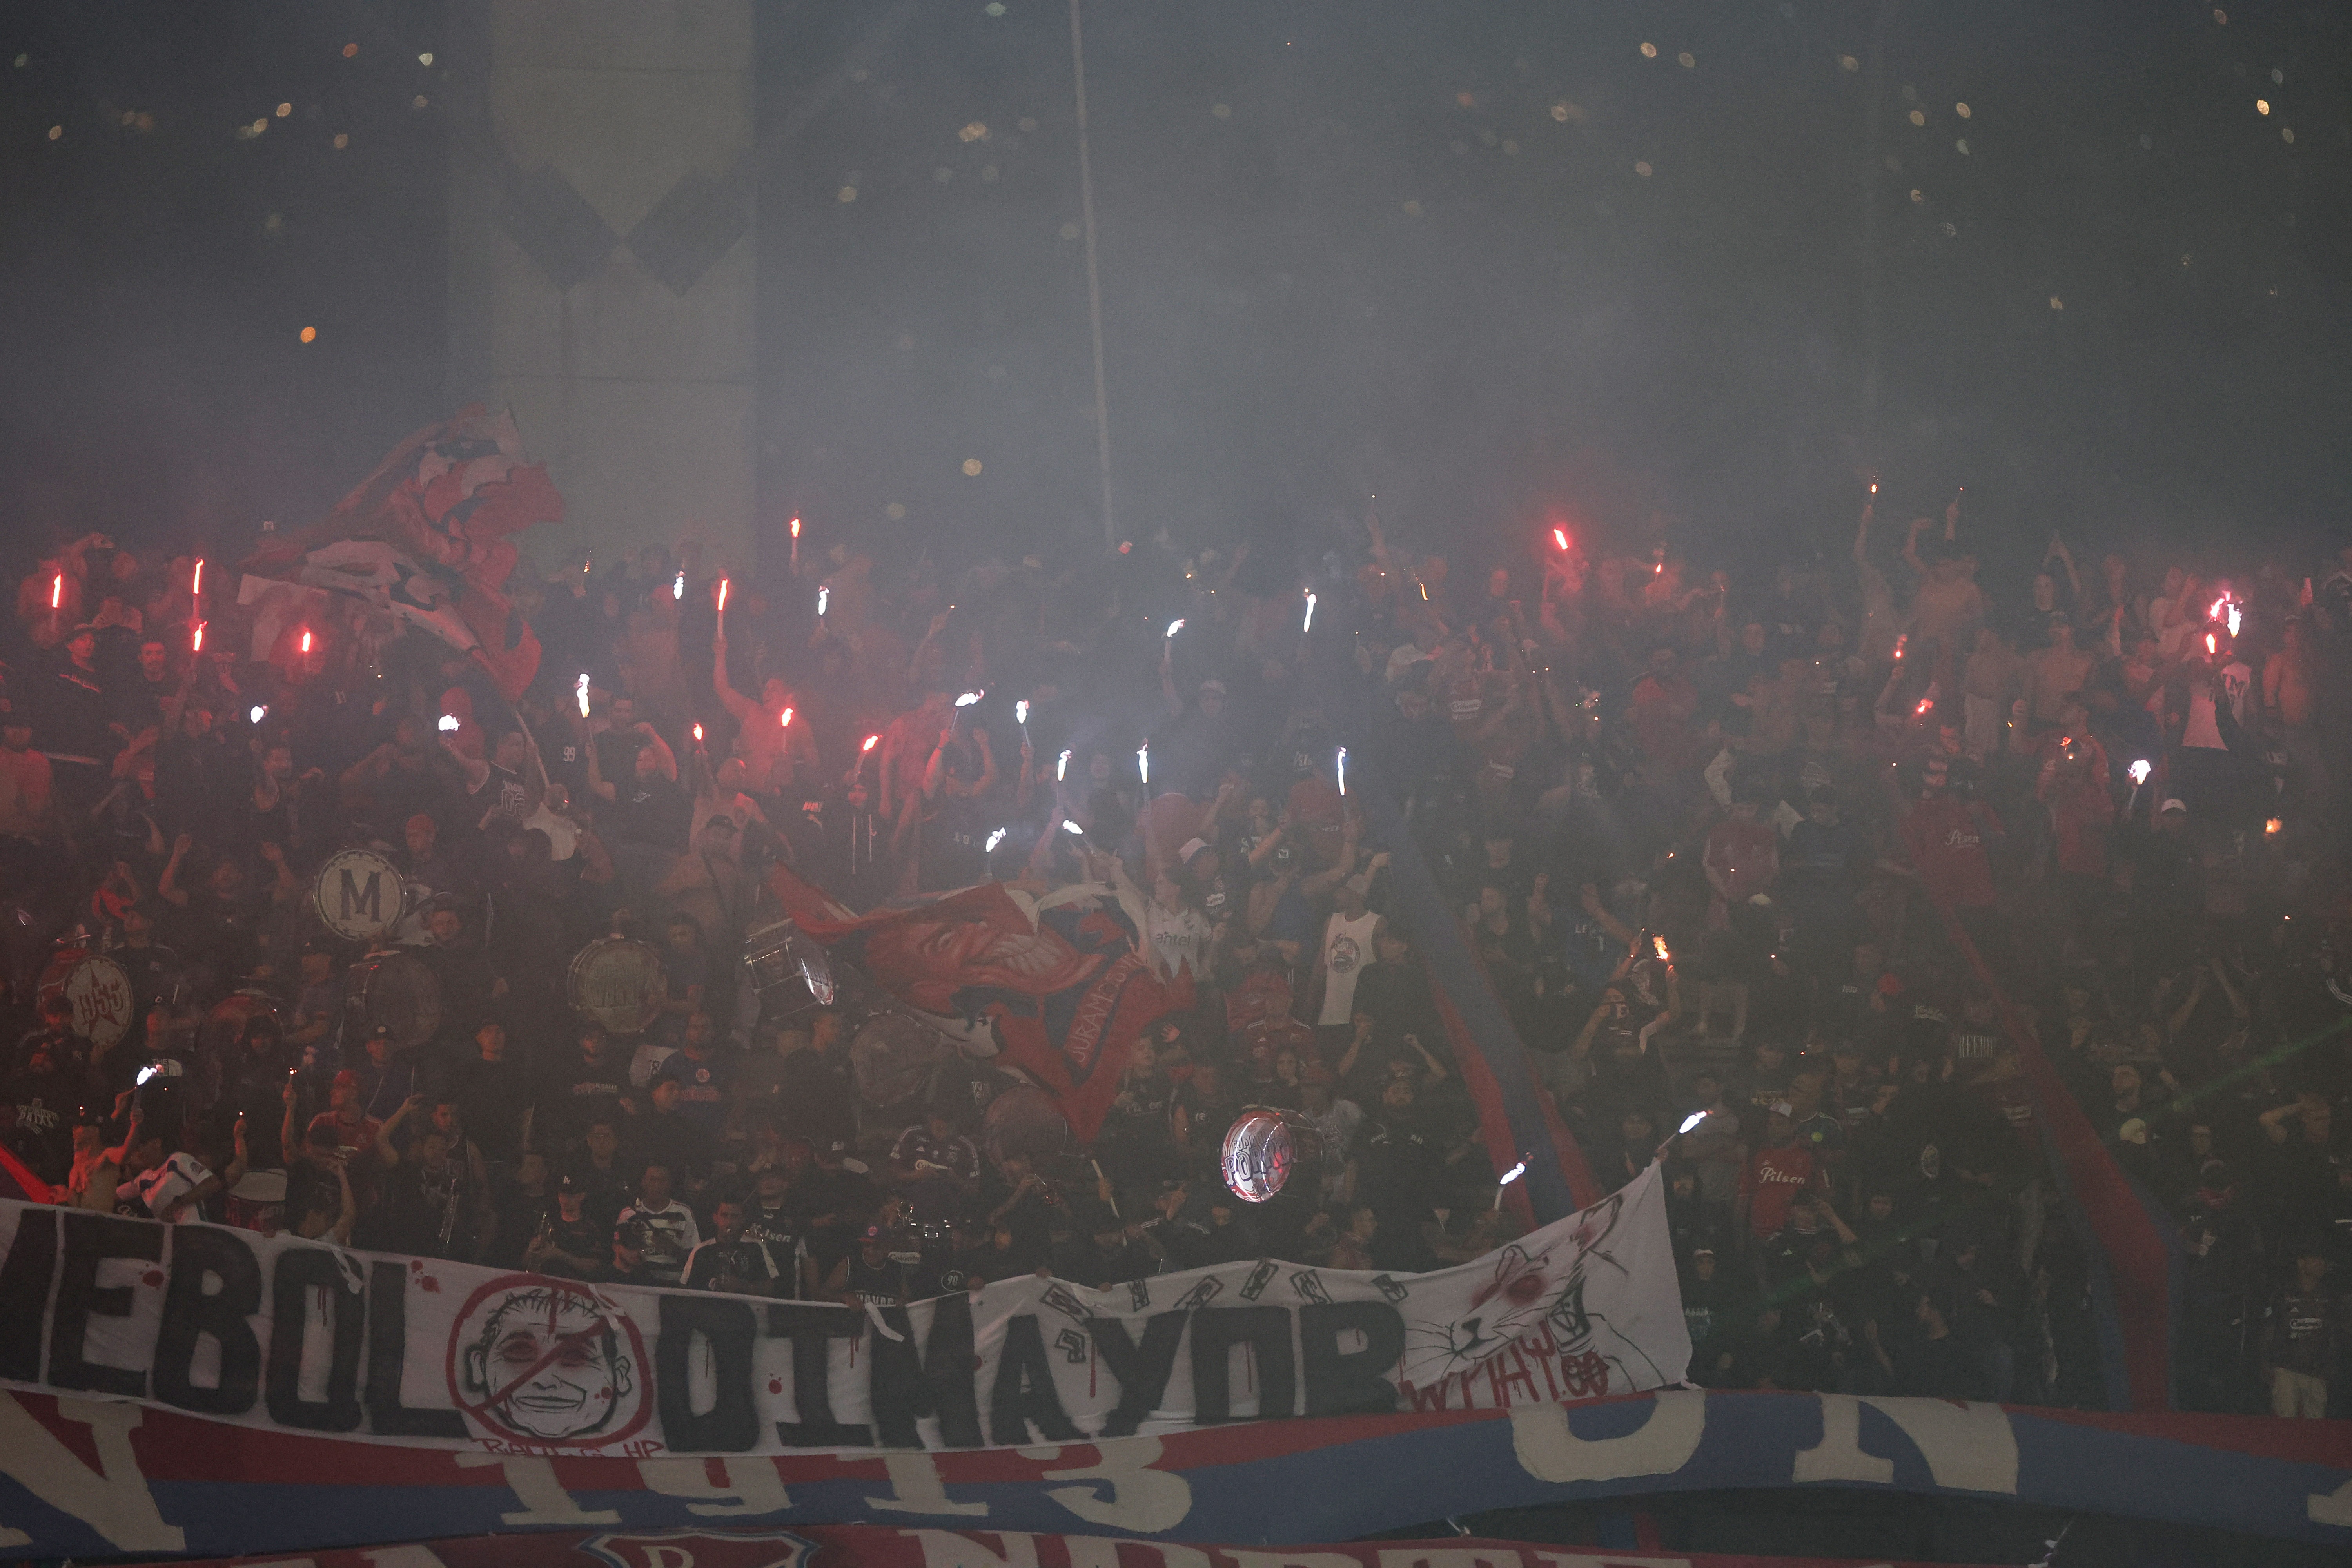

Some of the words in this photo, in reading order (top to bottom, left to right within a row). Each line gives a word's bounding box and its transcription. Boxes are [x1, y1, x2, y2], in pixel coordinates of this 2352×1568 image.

[563, 746, 575, 762] 99
[341, 868, 382, 922] M
[1224, 1136, 1290, 1186] PORRO
[1759, 1167, 1806, 1184] Pilsen
[948, 1275, 958, 1286] 90
